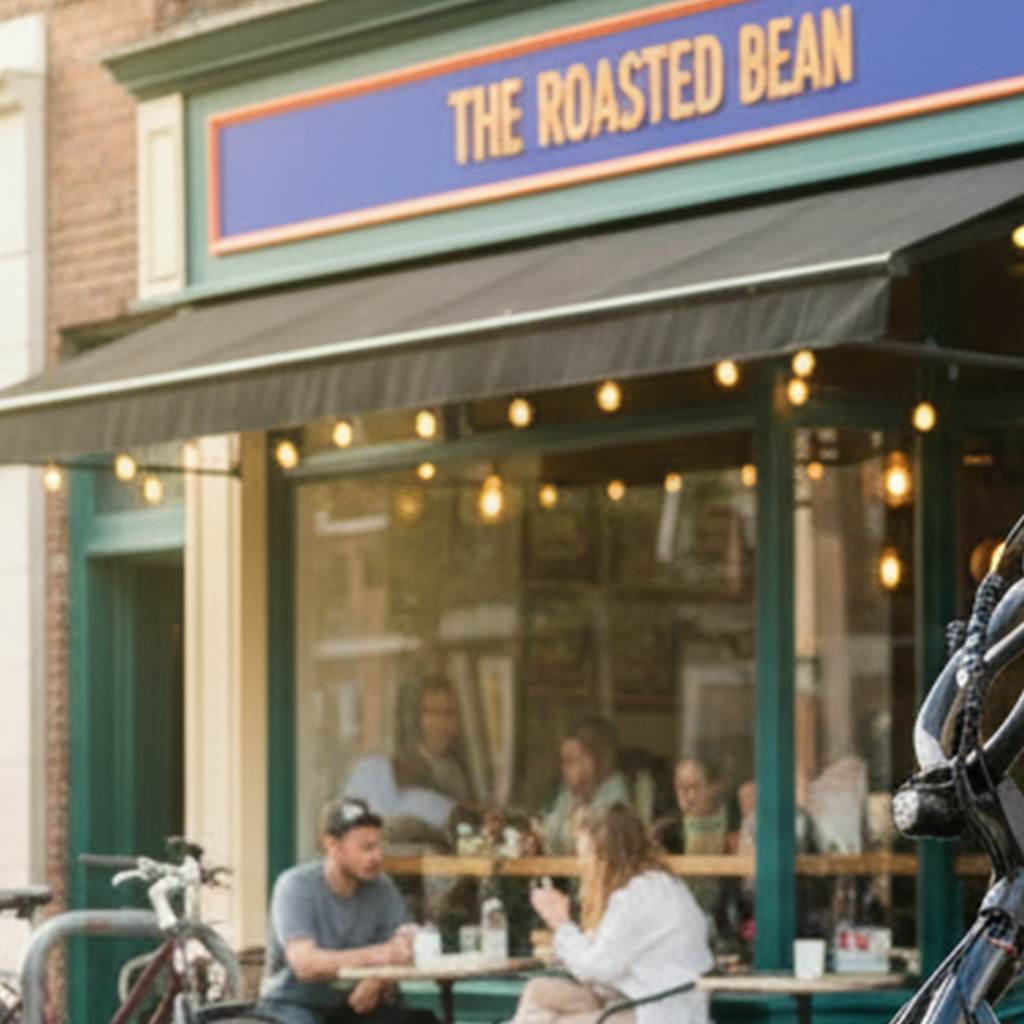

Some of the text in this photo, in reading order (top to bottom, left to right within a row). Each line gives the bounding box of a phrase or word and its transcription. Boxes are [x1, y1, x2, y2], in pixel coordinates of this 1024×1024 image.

[447, 4, 854, 165] THE ROASTED BEAN
